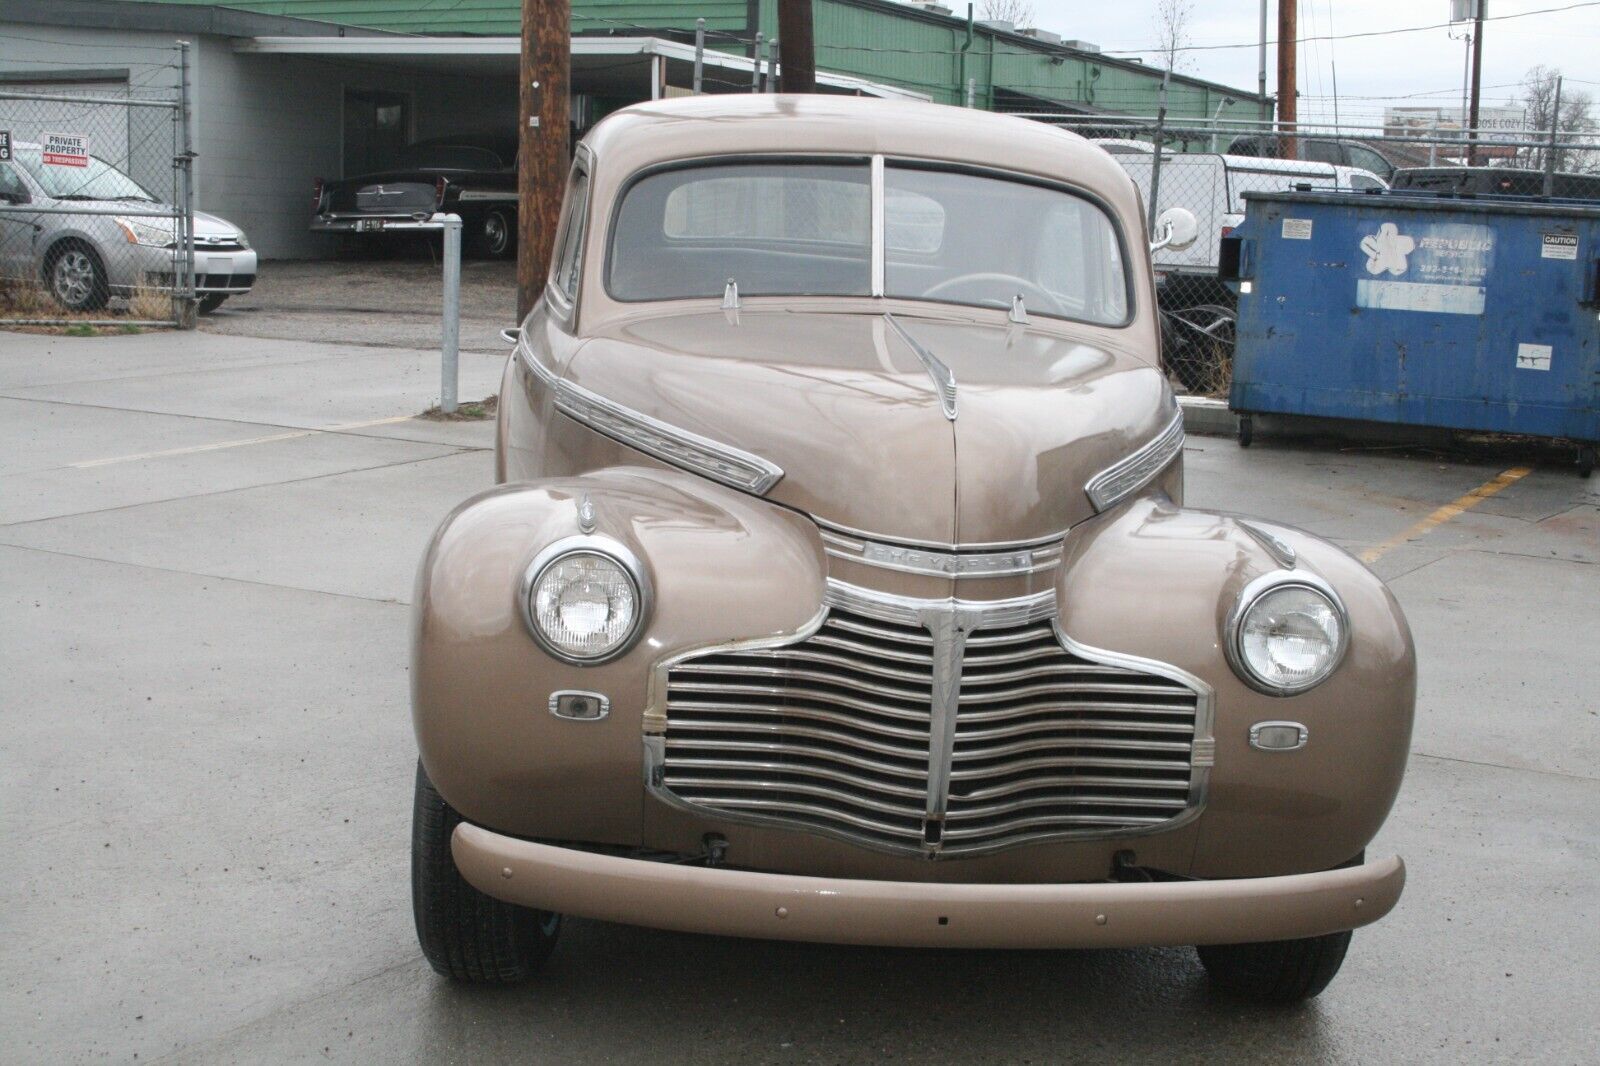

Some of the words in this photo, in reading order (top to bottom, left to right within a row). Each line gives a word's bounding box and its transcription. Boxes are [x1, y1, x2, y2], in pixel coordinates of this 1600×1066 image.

[1499, 118, 1521, 129] COZY
[49, 136, 82, 147] PRIVATE
[44, 144, 86, 155] PROPERTY
[1545, 236, 1577, 245] CAUTION
